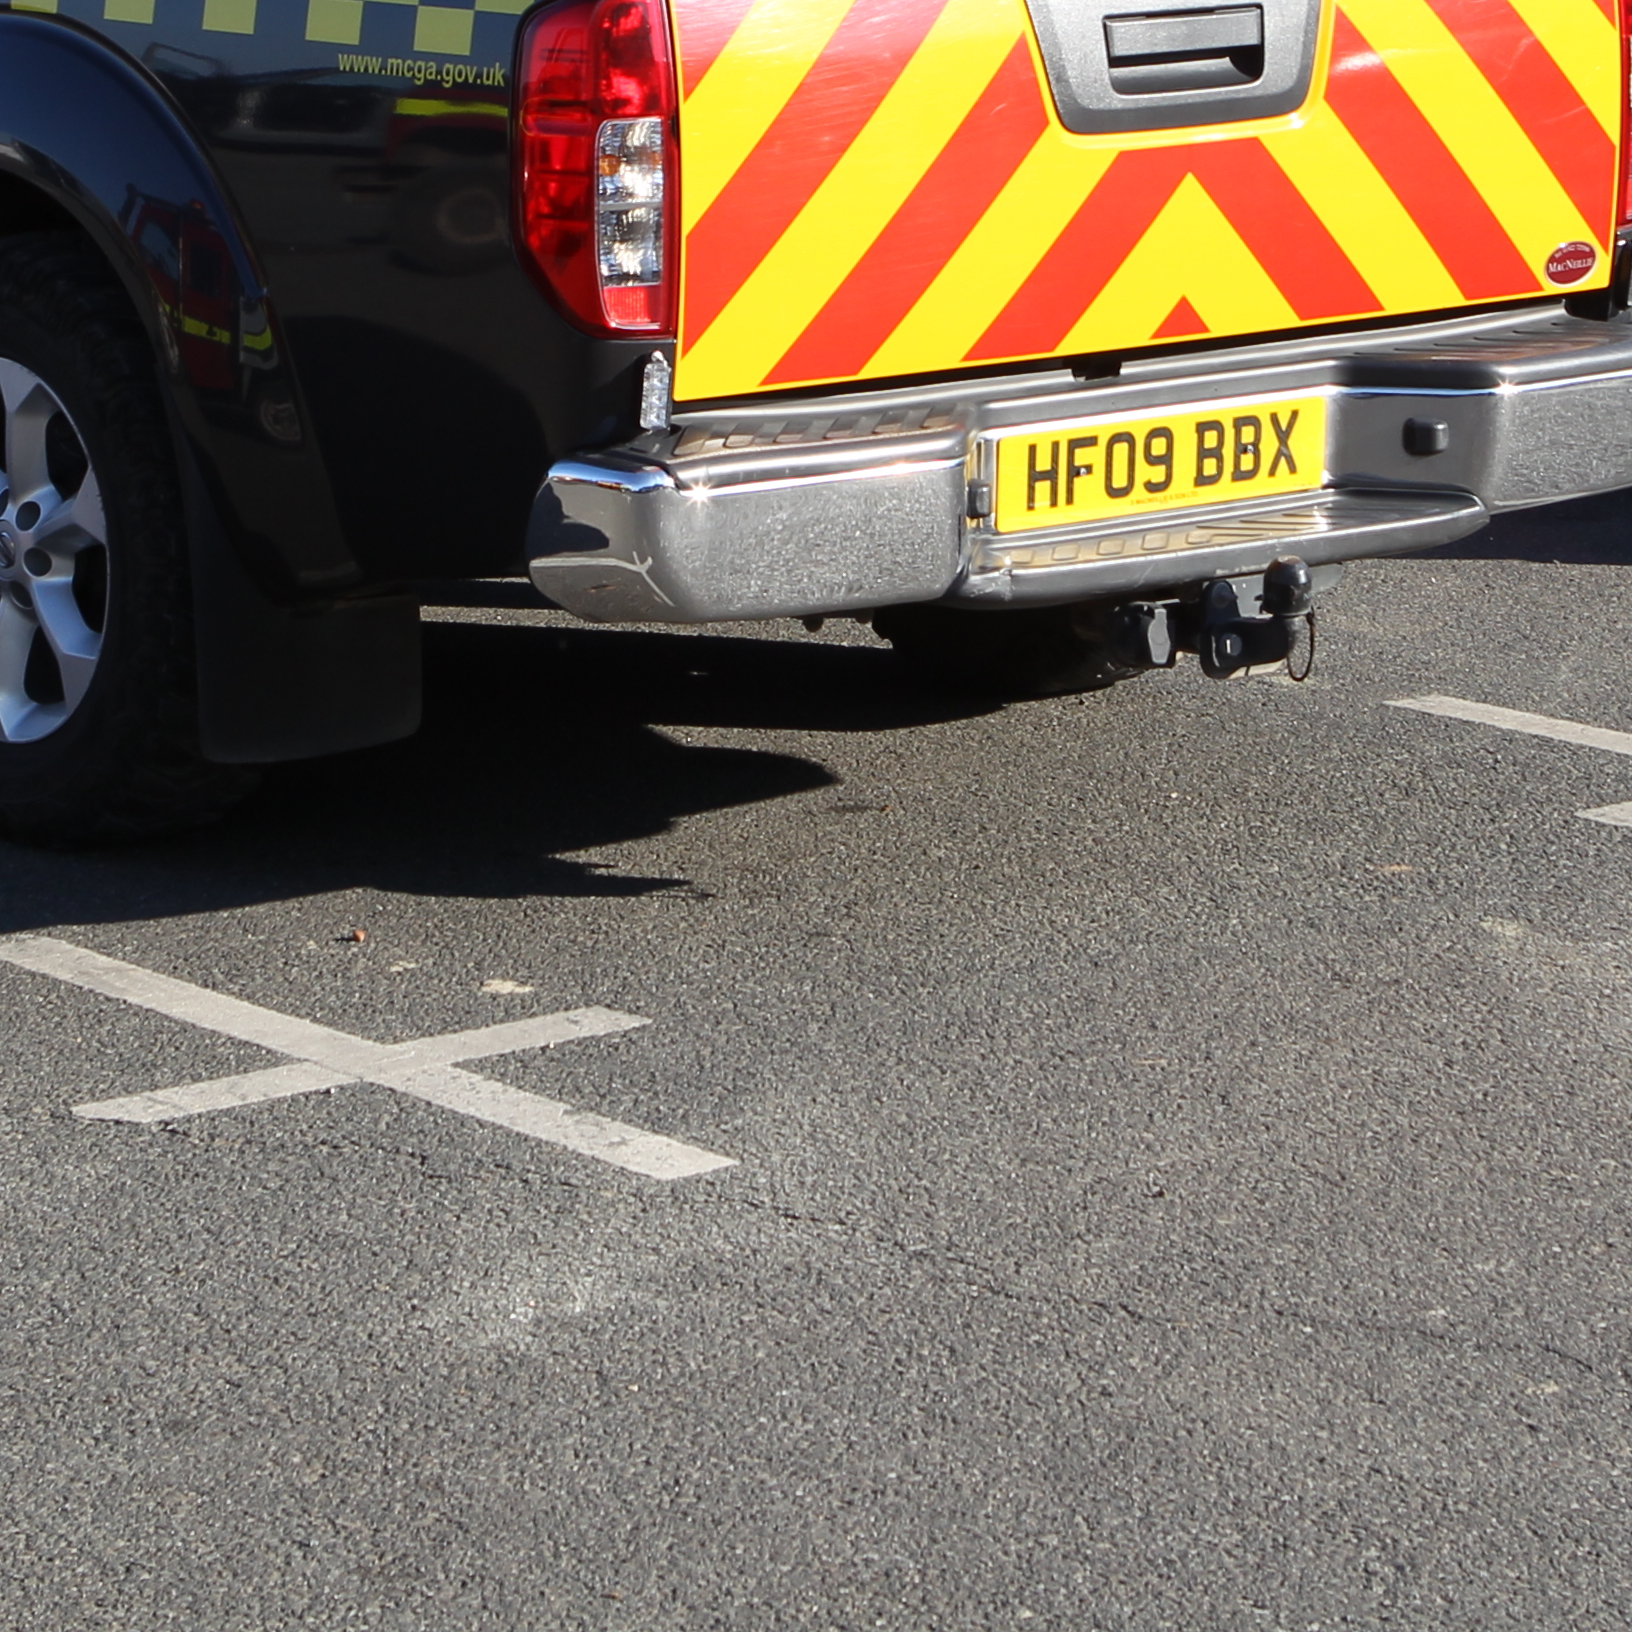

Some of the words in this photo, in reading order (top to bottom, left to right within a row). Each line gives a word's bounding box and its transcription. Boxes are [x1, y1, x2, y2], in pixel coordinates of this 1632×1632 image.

[338, 53, 506, 88] www.mcga.gov.uk
[1026, 426, 1174, 511] HF09
[1193, 409, 1300, 488] BBX
